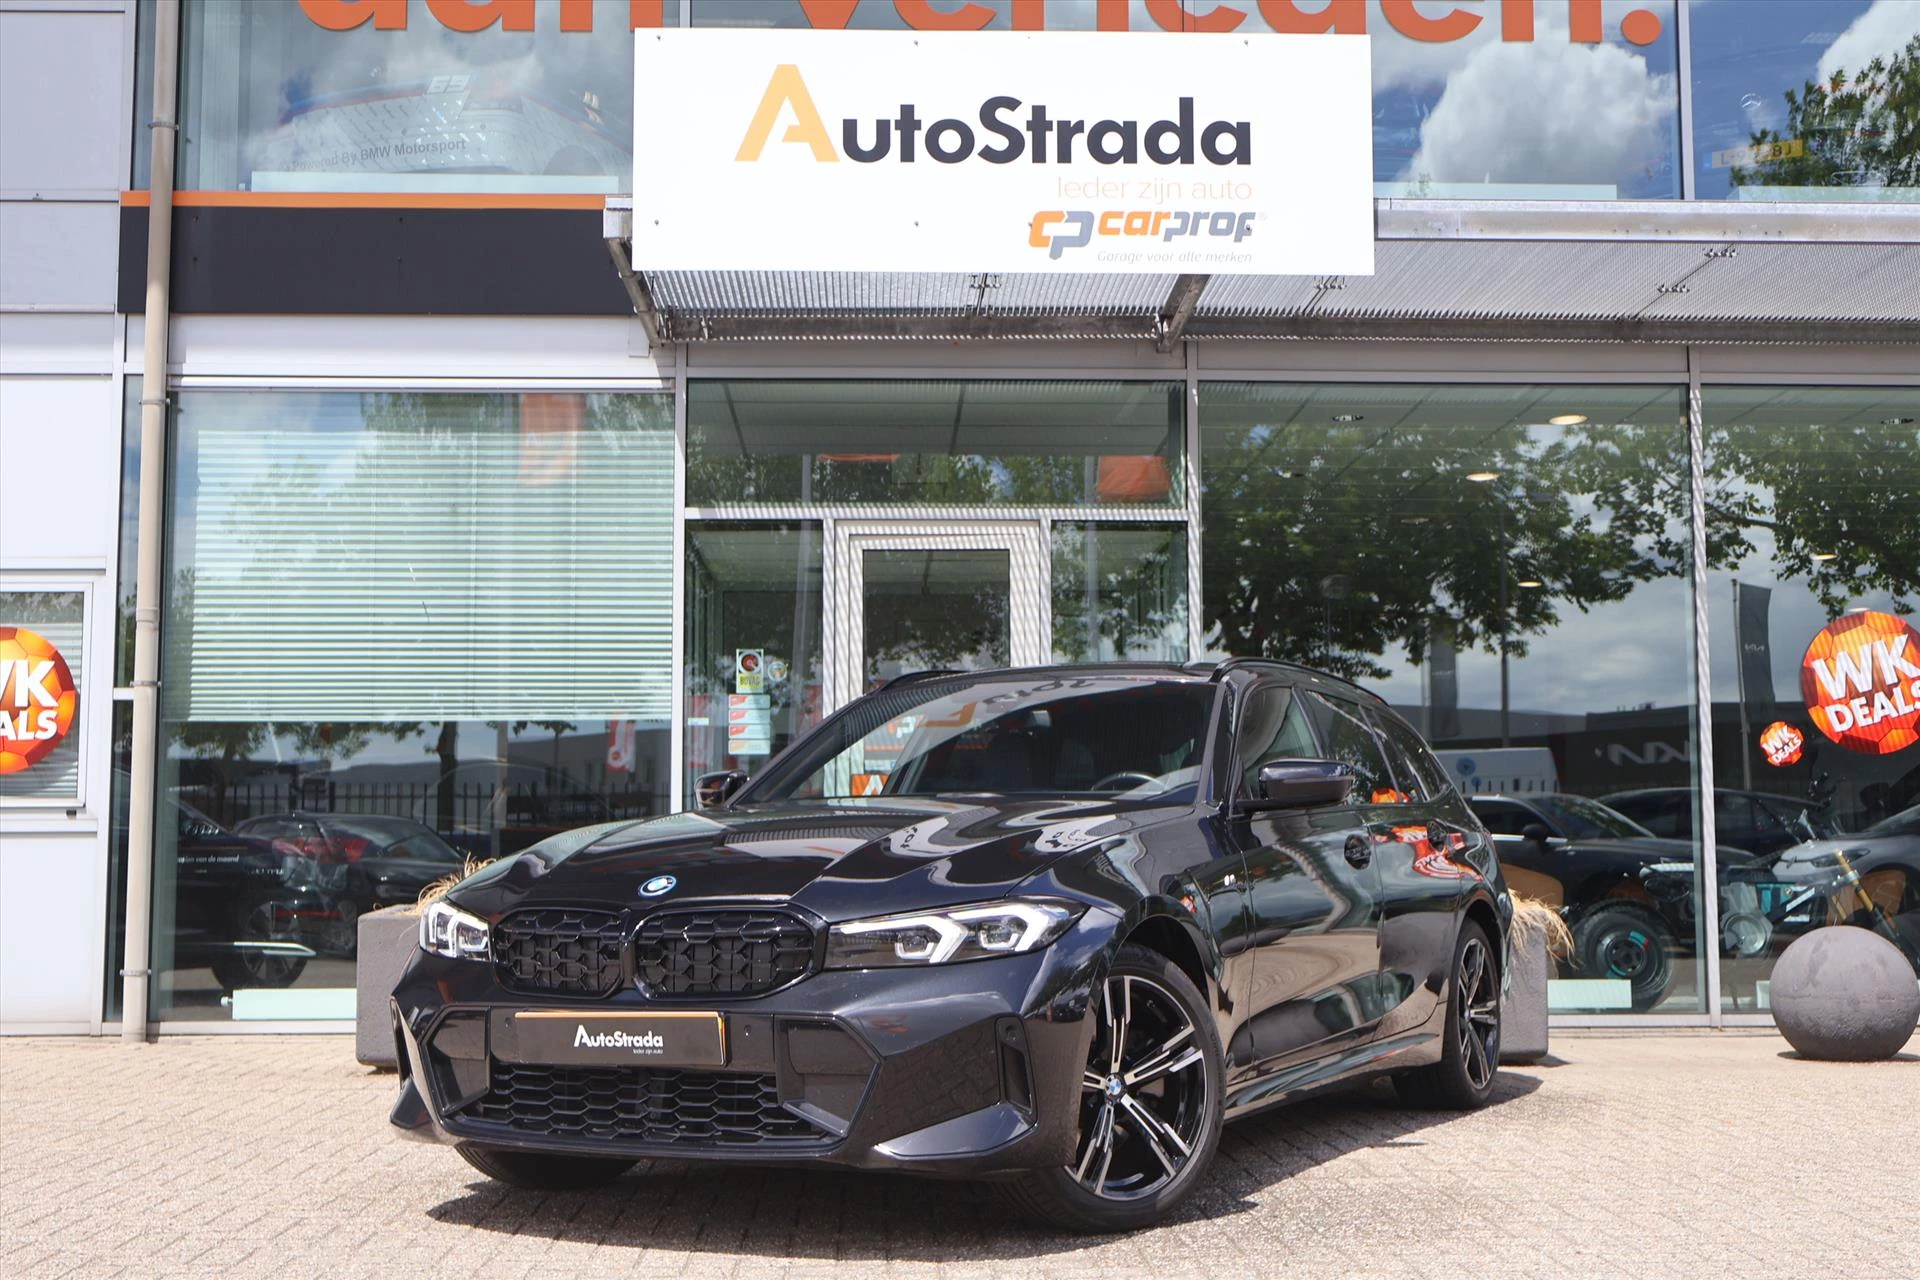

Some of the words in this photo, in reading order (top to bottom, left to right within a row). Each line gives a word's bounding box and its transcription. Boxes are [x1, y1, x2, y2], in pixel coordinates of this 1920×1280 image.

[735, 64, 1252, 166] AutoStrada
[360, 144, 391, 161] BMW
[394, 138, 467, 156] Motorsport
[1138, 176, 1182, 205] zijn
[1192, 180, 1253, 200] auto
[1097, 251, 1144, 265] Garage
[1147, 252, 1175, 263] voor
[1178, 251, 1203, 263] alle
[1205, 251, 1253, 264] merken
[1812, 634, 1920, 700] WK
[0, 659, 59, 708] K
[1762, 725, 1796, 755] WK
[1771, 737, 1802, 763] DEALS
[574, 1024, 664, 1048] AutoStrada
